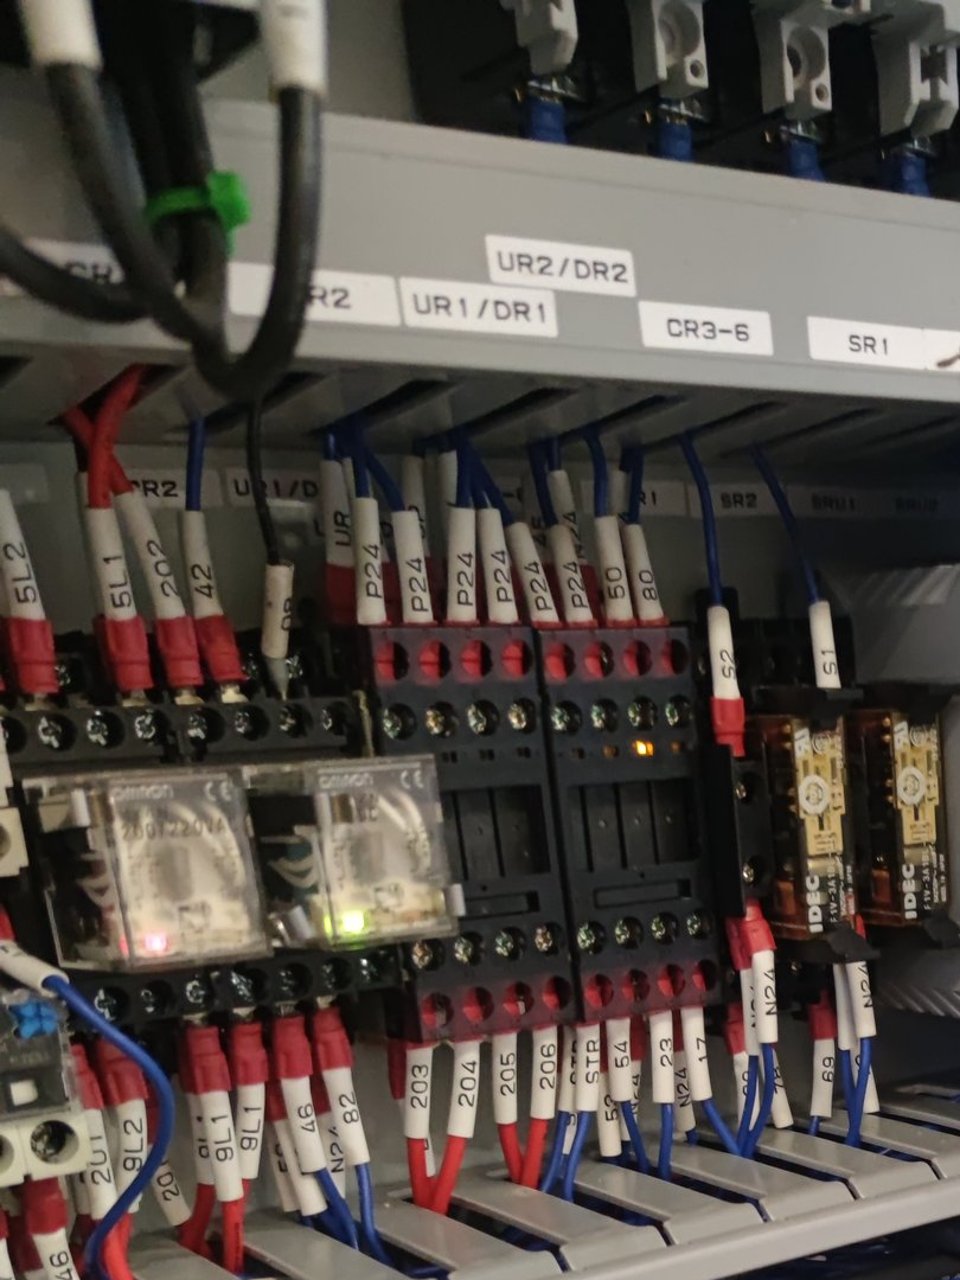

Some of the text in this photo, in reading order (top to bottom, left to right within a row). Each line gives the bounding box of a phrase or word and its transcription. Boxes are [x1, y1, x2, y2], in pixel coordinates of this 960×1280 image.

[497, 251, 628, 284] UR2/DR2
[306, 286, 351, 309] R2
[414, 293, 547, 324] UR1/DR1
[667, 318, 750, 342] CR3-6
[849, 335, 888, 355] SR1
[4, 541, 37, 604] 5L2
[103, 554, 132, 608] 5L1
[146, 539, 180, 598] 202
[191, 563, 214, 599] 42
[363, 543, 384, 600] P24
[409, 556, 430, 613] P24
[457, 552, 474, 607] P24
[490, 549, 514, 603] P24
[525, 560, 554, 612] P24
[563, 561, 587, 610] P24
[604, 566, 627, 600] 50
[805, 874, 823, 933] IDEC
[902, 863, 918, 920] IDEC
[499, 1052, 517, 1097] 205
[539, 1043, 557, 1089] 206
[586, 1039, 601, 1085] STR
[615, 1040, 631, 1069] 54
[659, 1037, 674, 1067] 23
[410, 1064, 429, 1109] 203
[457, 1060, 480, 1107] 204
[240, 1106, 263, 1152] 9L1
[297, 1102, 318, 1134] 46
[339, 1091, 360, 1124] 82
[123, 1117, 144, 1173] 9L2
[211, 1113, 235, 1162] 9L1
